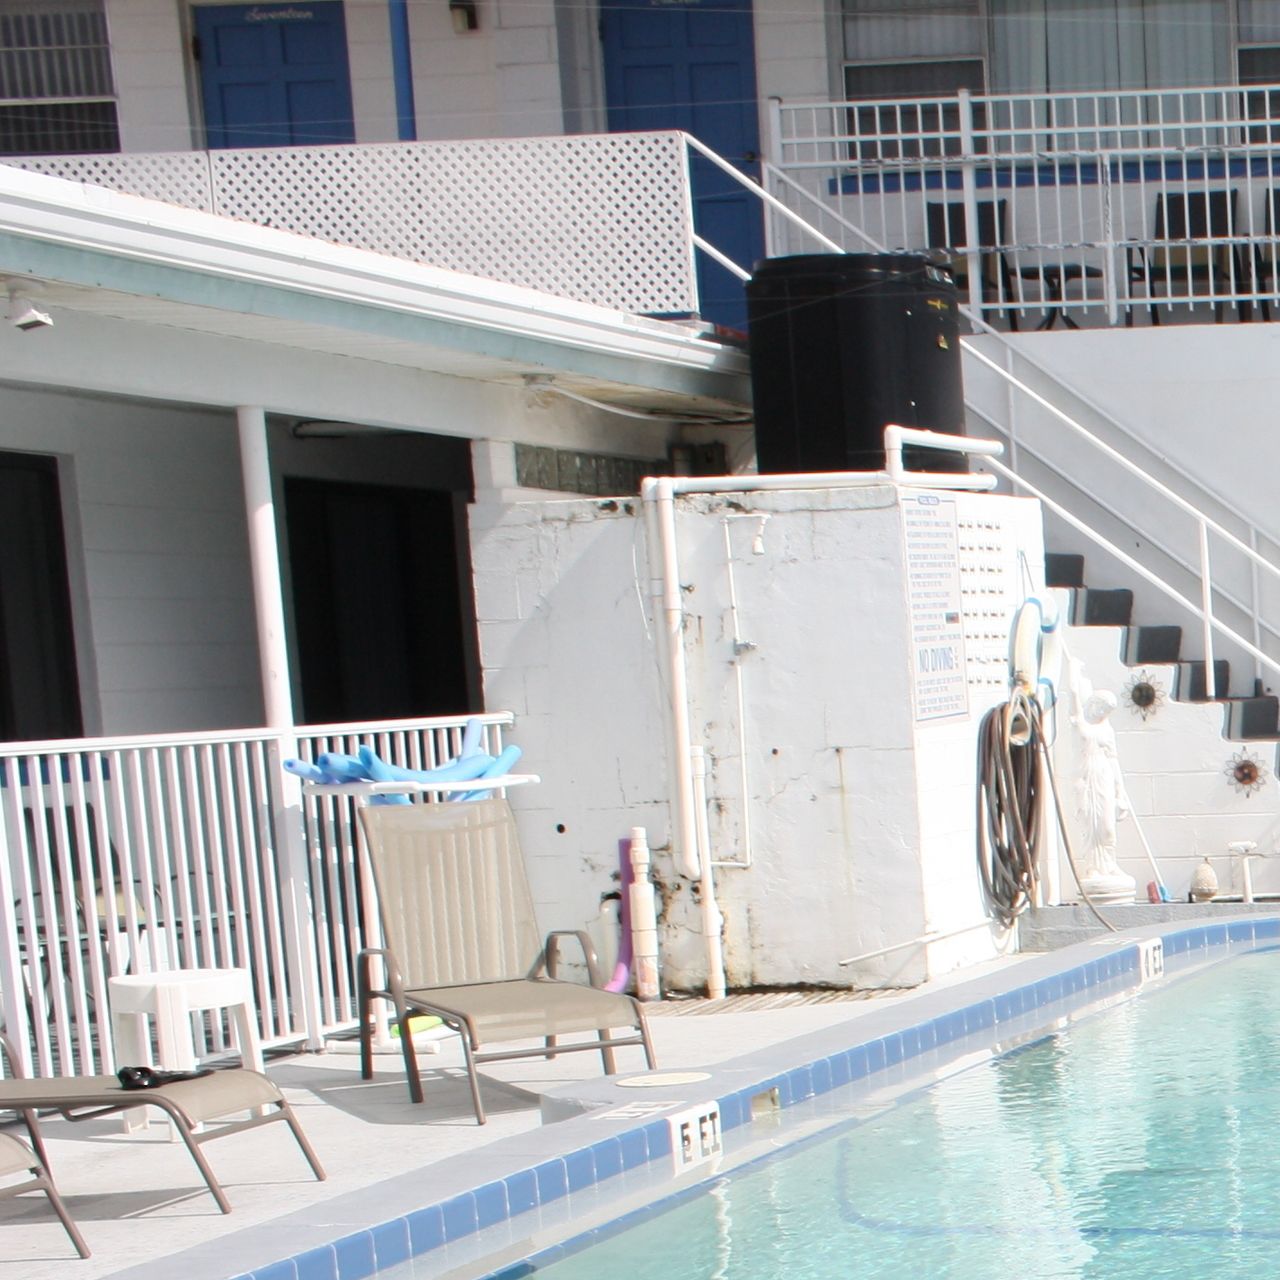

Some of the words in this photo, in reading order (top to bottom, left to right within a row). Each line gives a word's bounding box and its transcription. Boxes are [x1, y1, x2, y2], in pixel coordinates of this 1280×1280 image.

[919, 647, 930, 673] NO
[931, 646, 954, 672] DIVING
[698, 1112, 718, 1141] FT
